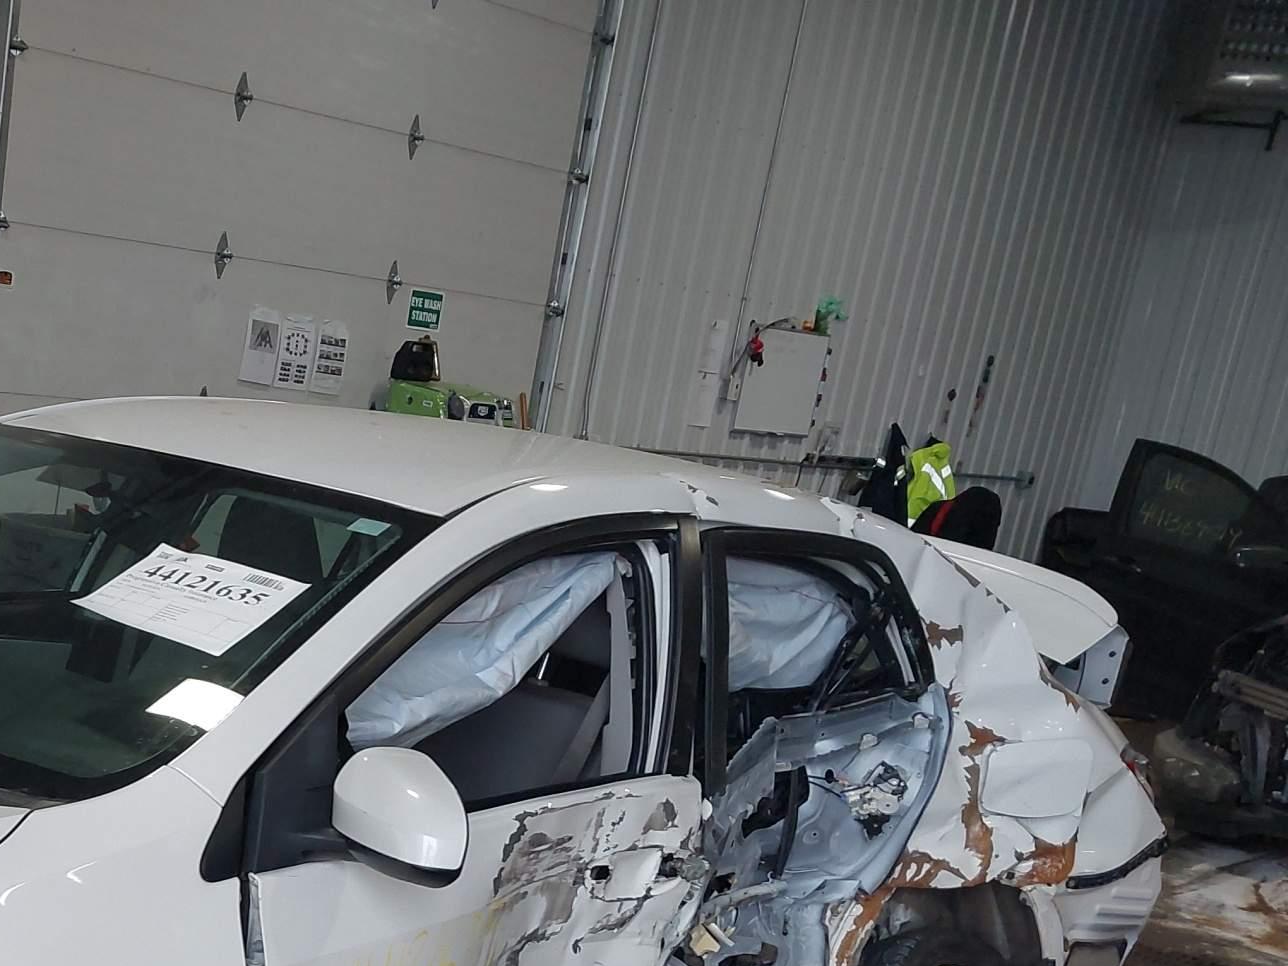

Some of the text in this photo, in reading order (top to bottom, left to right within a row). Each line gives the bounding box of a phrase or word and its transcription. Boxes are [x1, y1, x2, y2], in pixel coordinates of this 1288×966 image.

[411, 296, 442, 311] EYE WASH
[411, 310, 438, 323] STATION
[143, 563, 271, 606] 44121635
